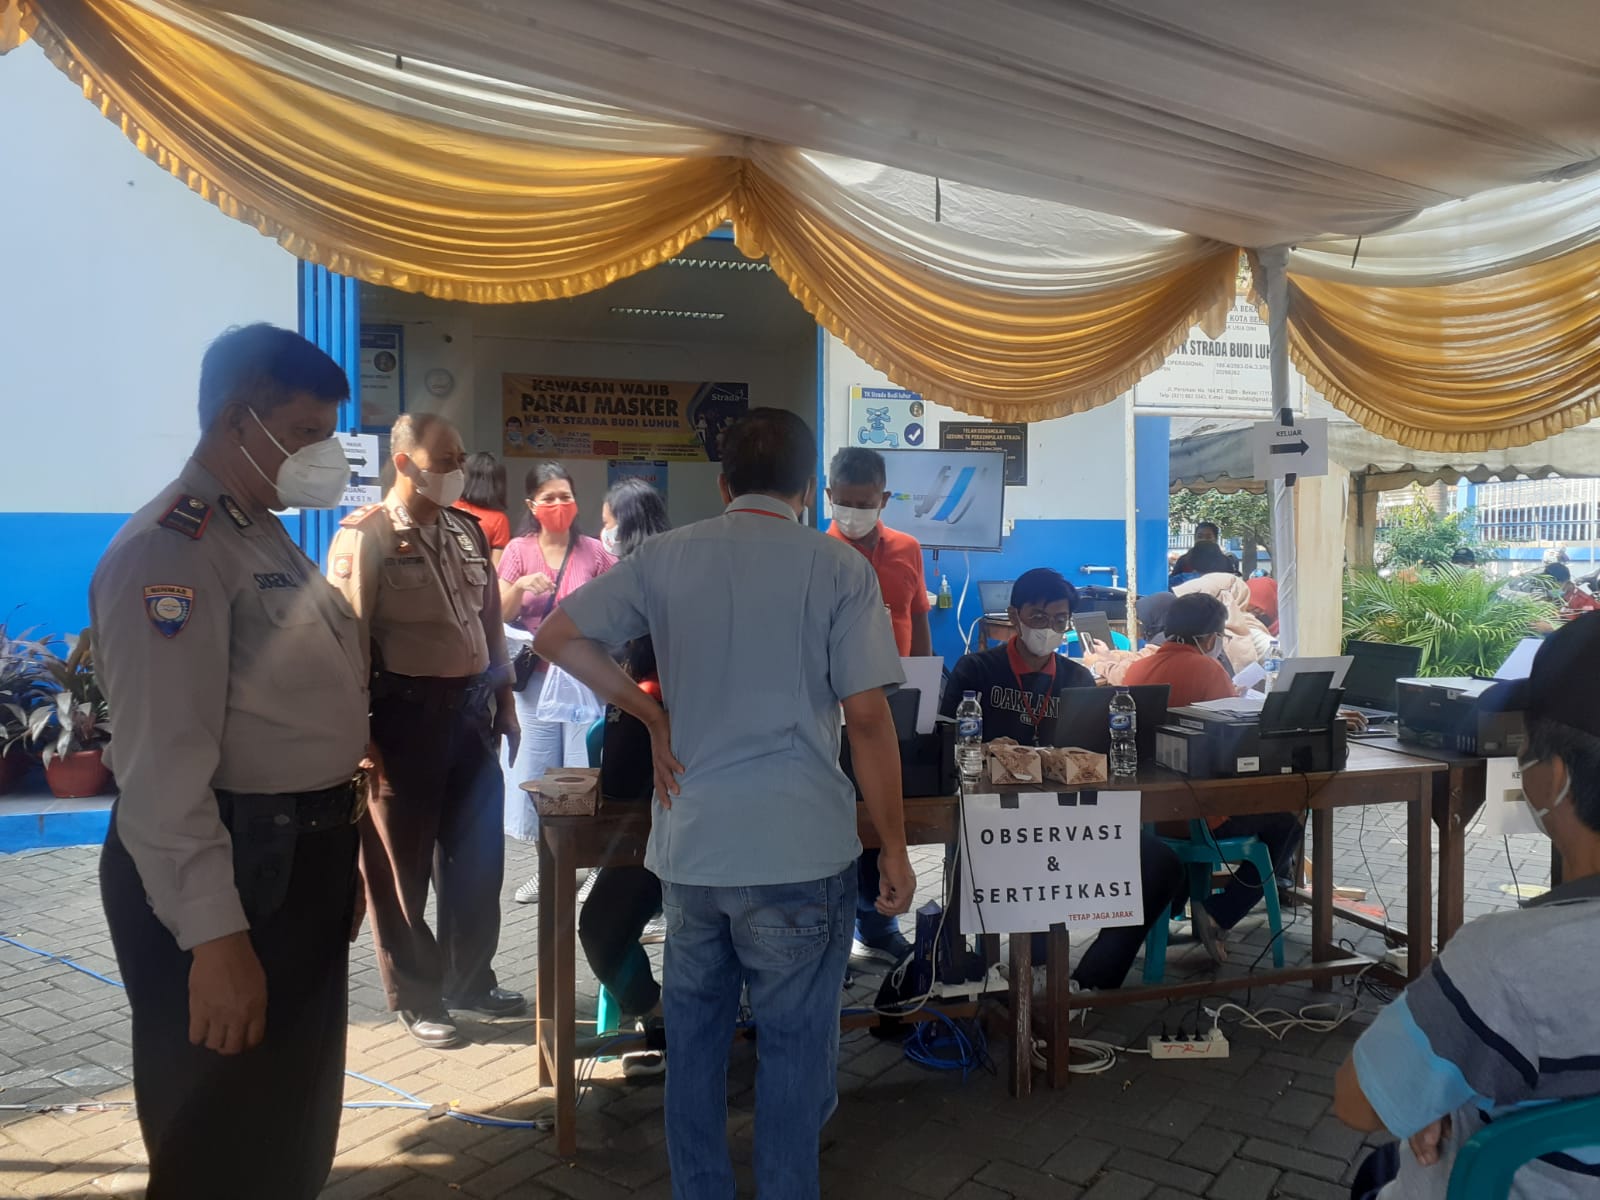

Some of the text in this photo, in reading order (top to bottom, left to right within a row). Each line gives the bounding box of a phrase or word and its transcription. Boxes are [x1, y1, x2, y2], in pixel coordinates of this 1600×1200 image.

[1190, 340, 1228, 357] STRADA
[1229, 342, 1252, 358] BUDI
[1255, 344, 1271, 359] LUH
[532, 379, 670, 396] KAWASAN WAJIB
[521, 392, 679, 417] PAKAI MASKER
[711, 393, 740, 402] Strada
[564, 416, 608, 426] STRADA
[612, 418, 639, 427] BUDI
[643, 419, 680, 429] LUHUR
[344, 495, 372, 503] AKSIN
[991, 686, 1060, 718] OAKLAN
[980, 824, 1123, 845] OBSERVASI
[1047, 855, 1061, 872] &
[972, 881, 1133, 905] SERTIFIKASI
[1068, 910, 1134, 921] TETAP JAGA JARAK
